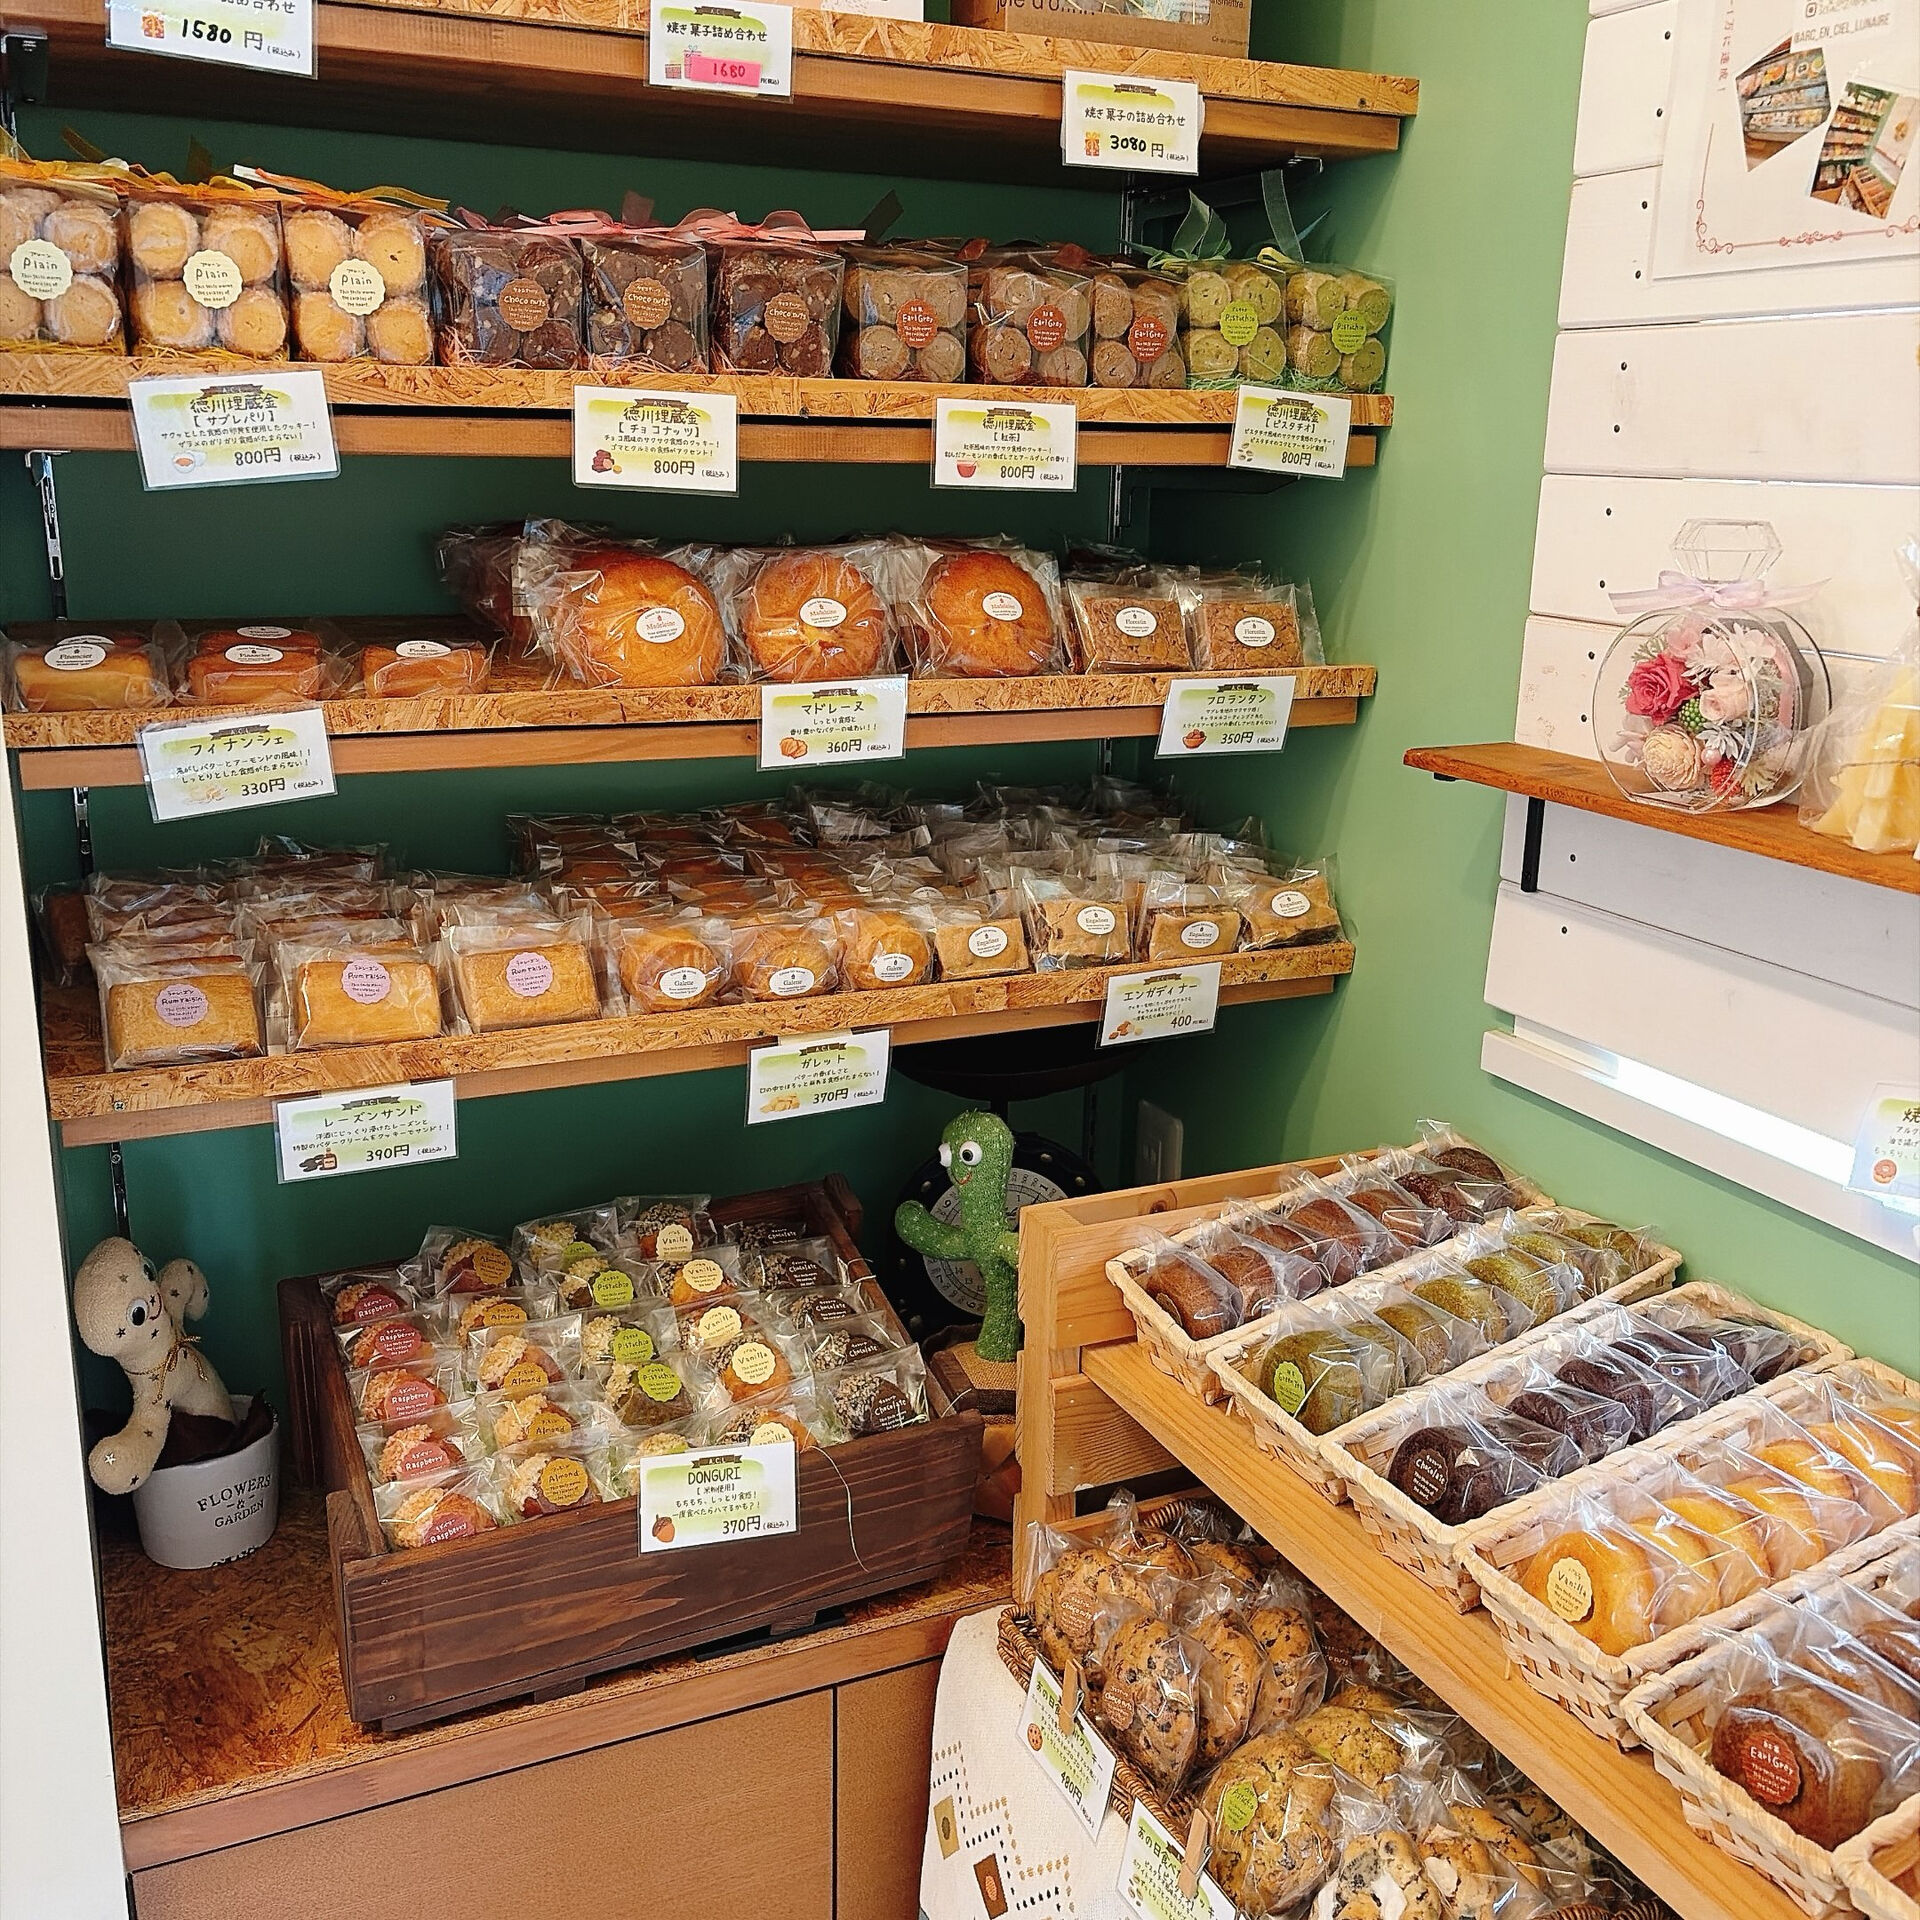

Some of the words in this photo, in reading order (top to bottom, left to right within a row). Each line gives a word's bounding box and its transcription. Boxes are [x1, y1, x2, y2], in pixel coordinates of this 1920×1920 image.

[182, 19, 231, 43] 1580
[244, 31, 263, 50] 円
[713, 63, 746, 78] 1680
[1085, 107, 1186, 126] 焼き菓子の詰め合わせ
[1110, 134, 1147, 152] 3080
[1152, 143, 1164, 158] 円
[23, 257, 58, 270] Plain
[196, 268, 229, 281] Plain
[341, 274, 372, 287] Plain
[504, 295, 528, 305] Choco
[530, 299, 547, 307] nuts
[628, 293, 651, 303] Choco
[652, 296, 669, 307] nuts
[769, 308, 790, 317] Choco
[790, 311, 807, 320] nuts
[902, 314, 916, 323] Earl
[916, 315, 933, 325] Grey
[1034, 318, 1047, 327] Earl
[1047, 320, 1063, 330] Grey
[1134, 330, 1149, 339] Earl
[1149, 331, 1165, 341] Grey
[189, 393, 278, 414] 徳川埋蔵金
[623, 408, 701, 425] 徳川埋蔵金
[1267, 405, 1321, 423] 徳川埋蔵金
[983, 418, 1036, 431] 徳川埋蔵金
[234, 447, 281, 466] 800円
[1281, 451, 1311, 466] 800円
[654, 460, 695, 476] 800円
[1000, 465, 1035, 479] 800円
[1207, 694, 1267, 705] フロランタン
[802, 701, 864, 715] マドレーヌ
[1221, 732, 1254, 744] 350円
[190, 735, 284, 756] フィナンシェ
[827, 739, 862, 753] 360円
[241, 777, 286, 797] 330円
[347, 972, 365, 981] Rum
[365, 973, 387, 981] raisin
[511, 967, 527, 976] Rum
[527, 965, 548, 973] raisin
[1123, 983, 1198, 1002] エンガディナー
[161, 998, 178, 1006] Rum
[178, 996, 203, 1004] raisin
[1171, 1014, 1192, 1028] 400
[801, 1055, 846, 1069] ガレット
[813, 1088, 849, 1105] 370円
[324, 1105, 422, 1128] レーズンサンド
[366, 1144, 410, 1162] 390円
[662, 1236, 689, 1246] Vanilla
[688, 1266, 716, 1276] Vanilla
[598, 1281, 629, 1292] Pistachio
[359, 1302, 392, 1318] Raspberry
[815, 1301, 847, 1312] Chocolate
[491, 1313, 520, 1322] Almond
[703, 1314, 734, 1331] Vanilla
[380, 1331, 415, 1341] Raspberry
[618, 1340, 649, 1350] Pistachio
[849, 1344, 878, 1358] Chocolate
[738, 1352, 768, 1364] Vanilla
[510, 1376, 542, 1386] Almond
[643, 1372, 676, 1381] Pistachio
[392, 1392, 431, 1404] Raspberry
[874, 1398, 907, 1416] Chocolate
[535, 1426, 565, 1434] Almond
[405, 1454, 444, 1471] Raspberry
[548, 1470, 579, 1483] Almond
[688, 1466, 742, 1485] DONGURI
[1415, 1458, 1445, 1485] Chocolate
[196, 1474, 271, 1512] FLOWERS
[214, 1498, 264, 1528] GARDEN
[722, 1515, 761, 1535] 370円
[430, 1522, 467, 1544] Raspberry
[1558, 1570, 1586, 1597] Vanilla
[1061, 1602, 1080, 1615] Choco
[1080, 1609, 1092, 1619] nuts
[1105, 1693, 1121, 1704] Choco
[1750, 1746, 1771, 1763] Earl
[1772, 1756, 1793, 1775] Grey
[1059, 1767, 1082, 1808] 480円
